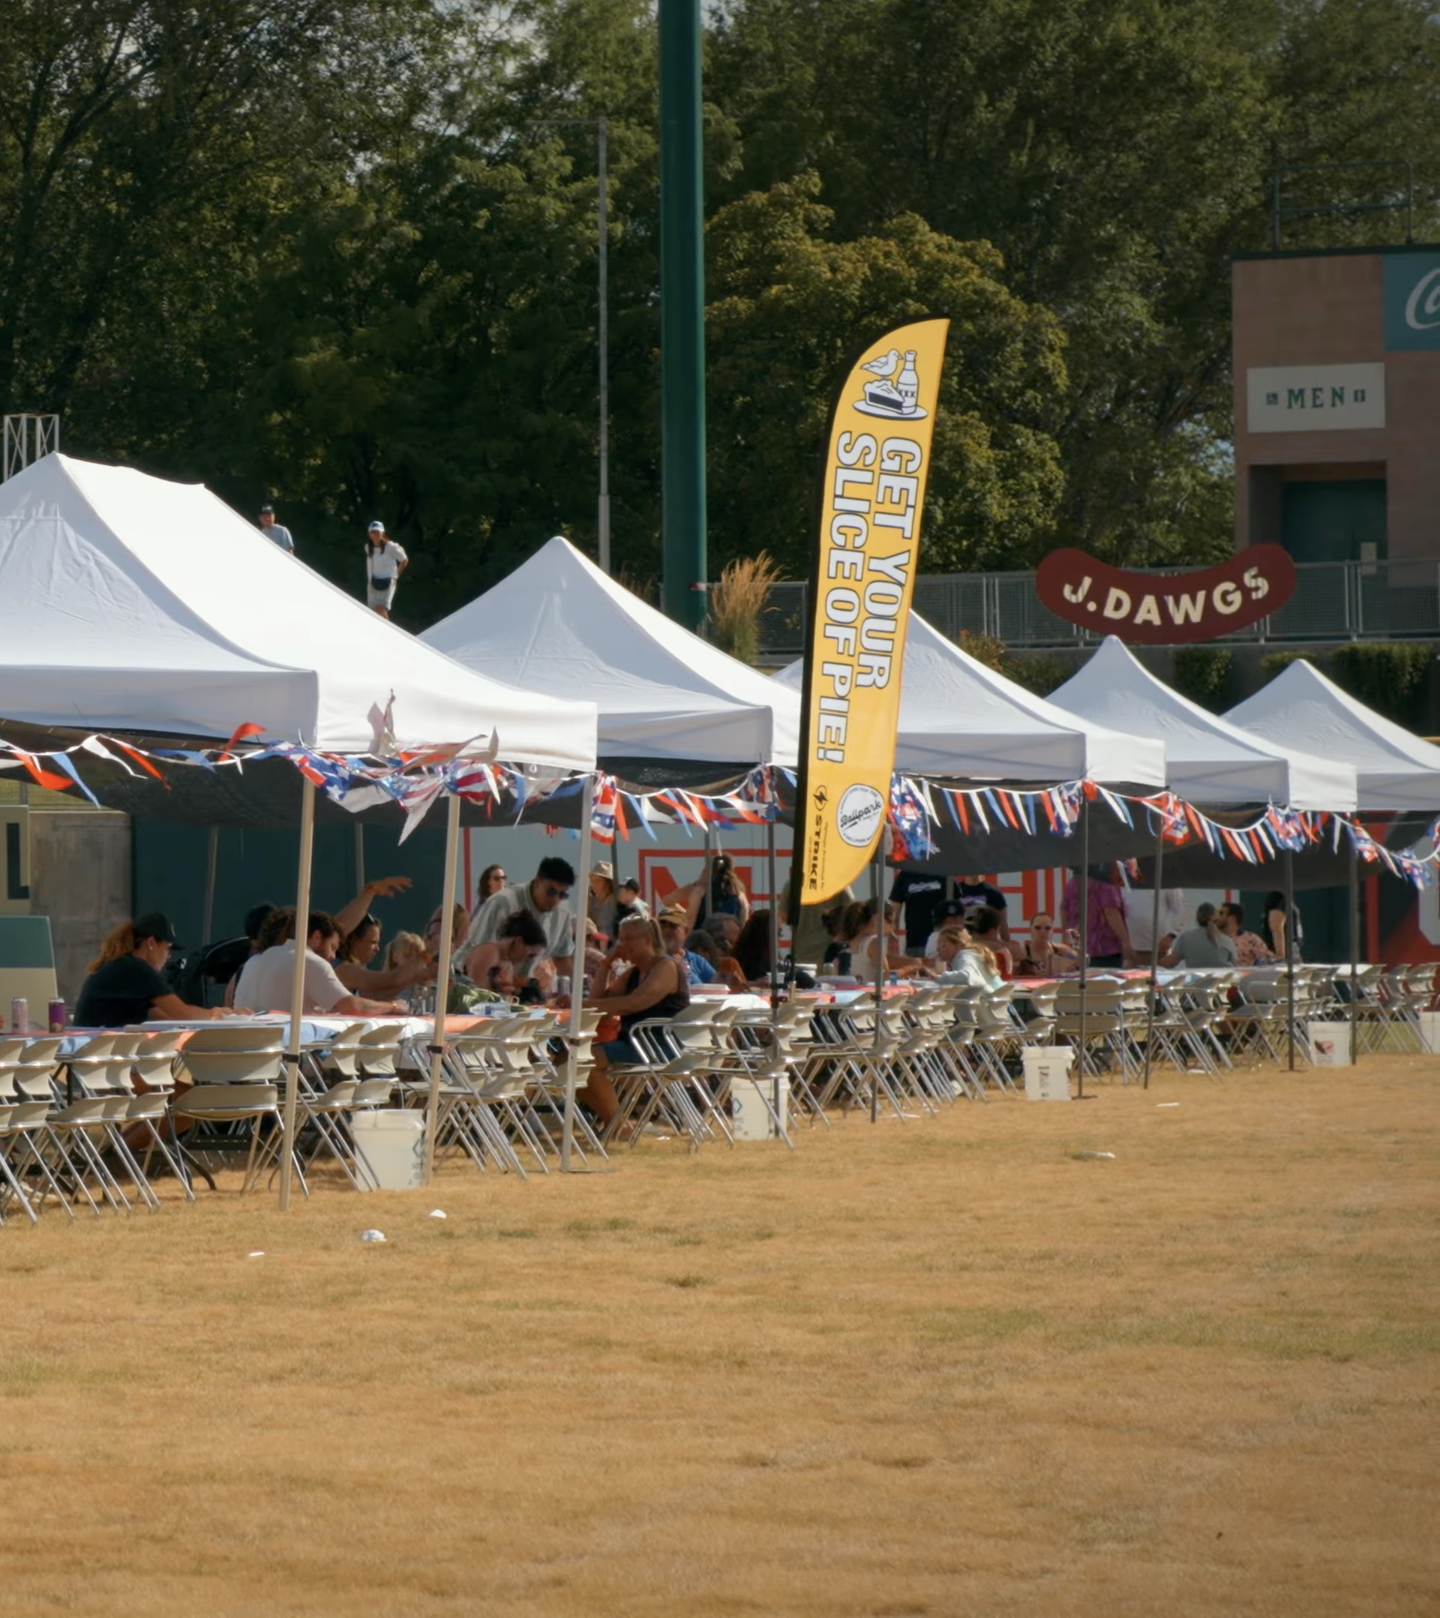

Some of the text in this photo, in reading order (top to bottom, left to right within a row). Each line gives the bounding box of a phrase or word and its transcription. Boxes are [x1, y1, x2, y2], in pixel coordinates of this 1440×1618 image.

[1287, 386, 1345, 409] MEN
[816, 430, 878, 764] SLICE OF PIE!
[855, 436, 923, 689] GET YOUR
[840, 799, 882, 828] Ballpark
[809, 814, 823, 890] STRIKE
